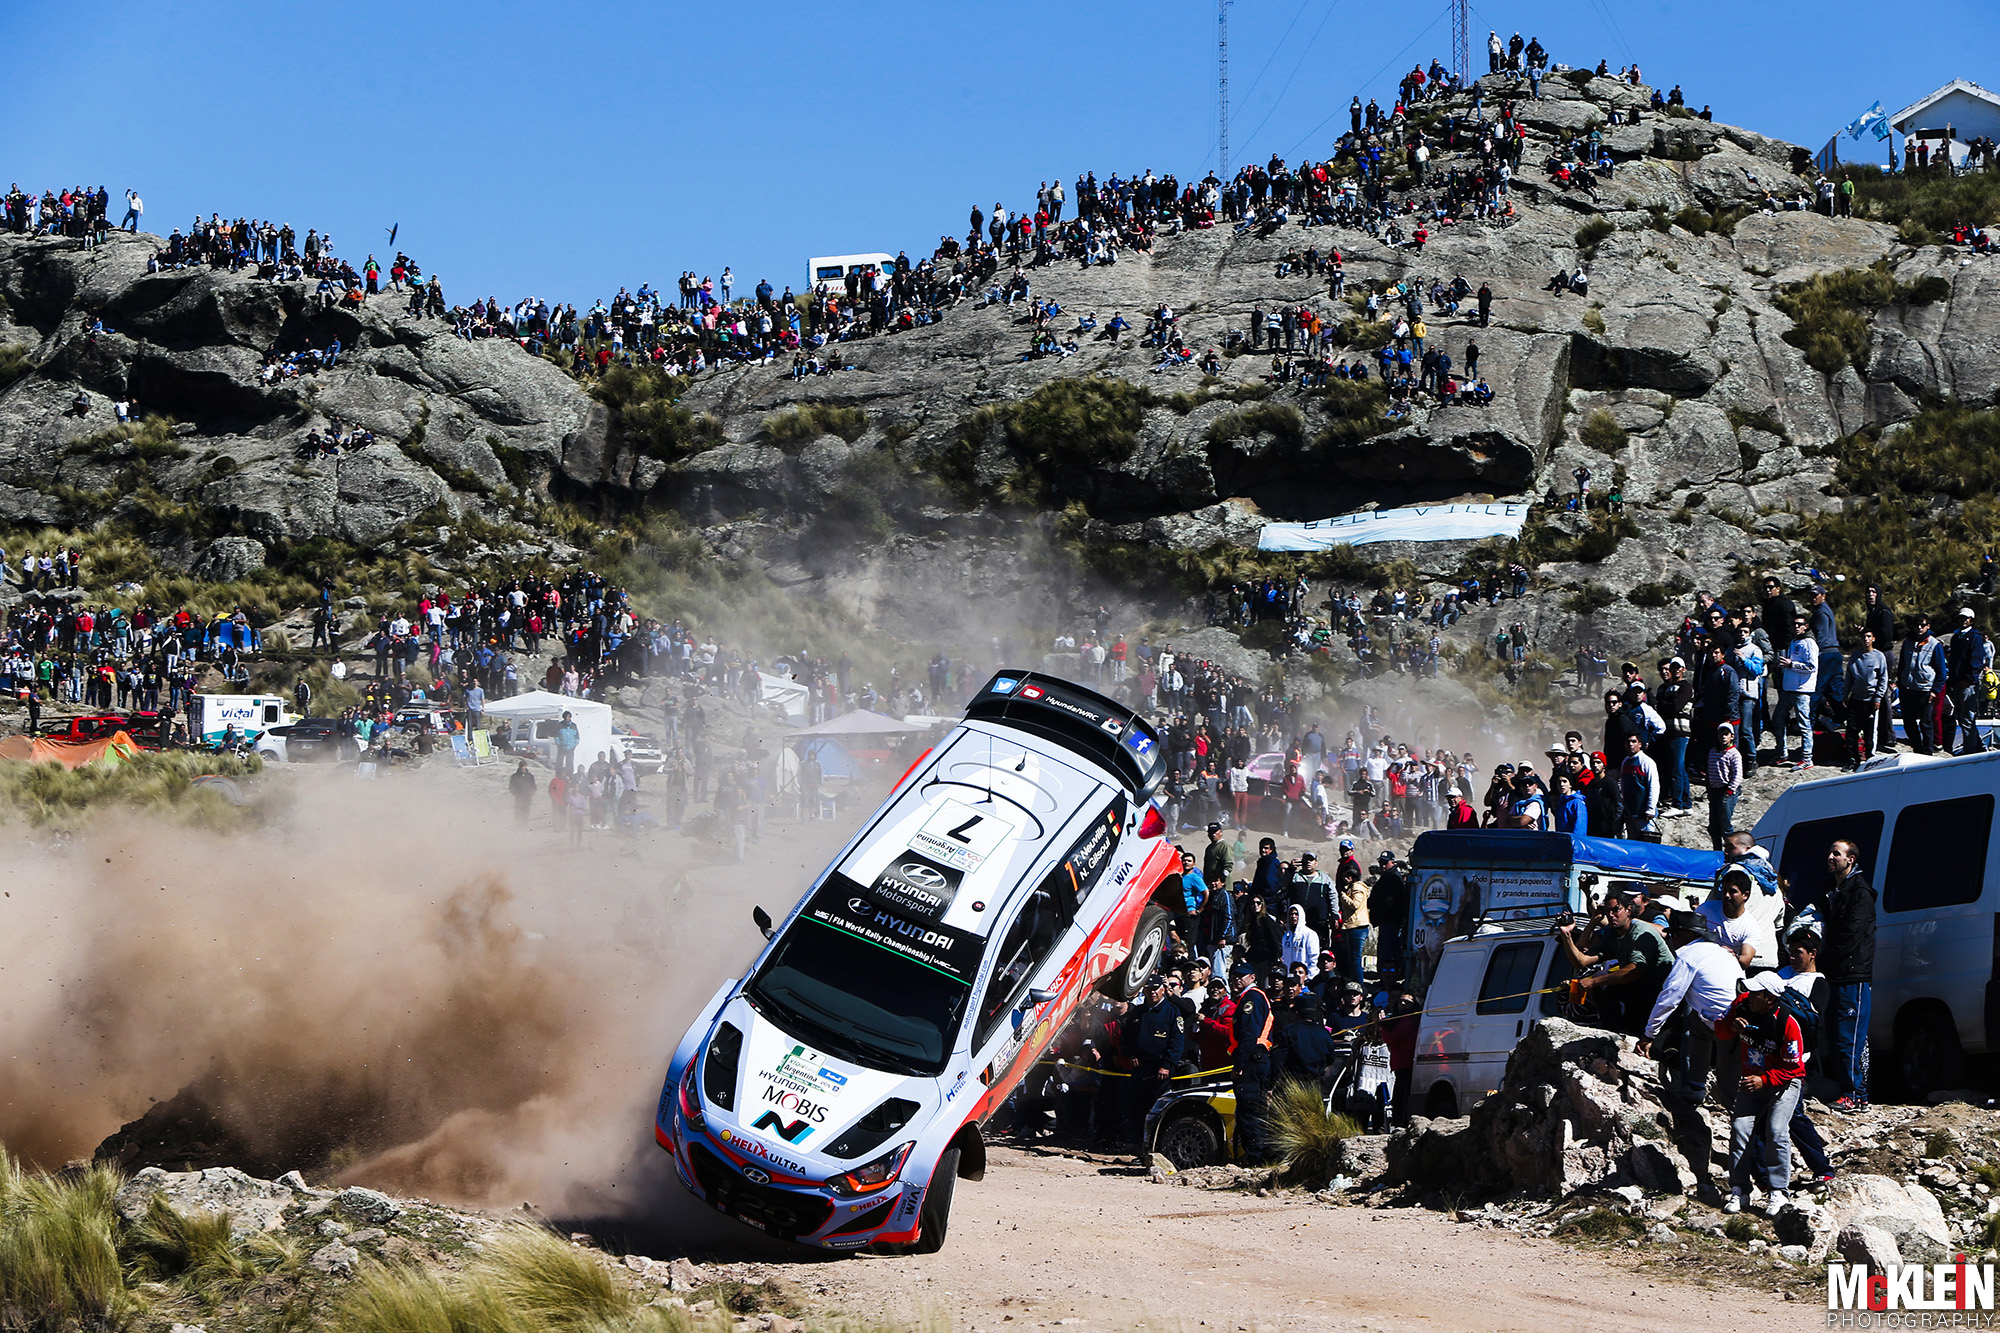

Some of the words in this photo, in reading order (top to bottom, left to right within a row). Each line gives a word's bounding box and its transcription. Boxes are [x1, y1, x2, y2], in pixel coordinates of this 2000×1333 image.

[946, 814, 984, 844] 7
[1080, 824, 1107, 860] Neuville
[1079, 867, 1089, 881] N.
[1088, 836, 1111, 869] Gilsoul
[881, 876, 942, 908] HYUNDAI
[1471, 874, 1488, 883] Todo
[1490, 877, 1506, 886] para
[1519, 877, 1552, 886] pequeños
[1496, 890, 1502, 898] y
[1502, 890, 1529, 899] grandes
[1530, 889, 1560, 898] animales
[875, 885, 935, 916] Motorsport
[832, 916, 844, 926] FIA
[845, 921, 866, 934] World
[865, 928, 883, 942] Rally
[883, 936, 930, 962] Championship
[873, 911, 955, 950] HYUNDAI
[1414, 928, 1426, 945] 80
[963, 959, 989, 1030] motorsport.hyundai.com
[1035, 972, 1064, 1016] MBIS
[1050, 938, 1131, 1027] HELIX
[784, 1064, 818, 1082] Argentina
[810, 1053, 817, 1061] 7
[759, 1070, 808, 1094] HYUNDAI
[762, 1085, 829, 1122] MOBIS
[730, 1135, 768, 1160] HELIX
[769, 1153, 806, 1176] ULTRA
[859, 1195, 889, 1210] HELIX
